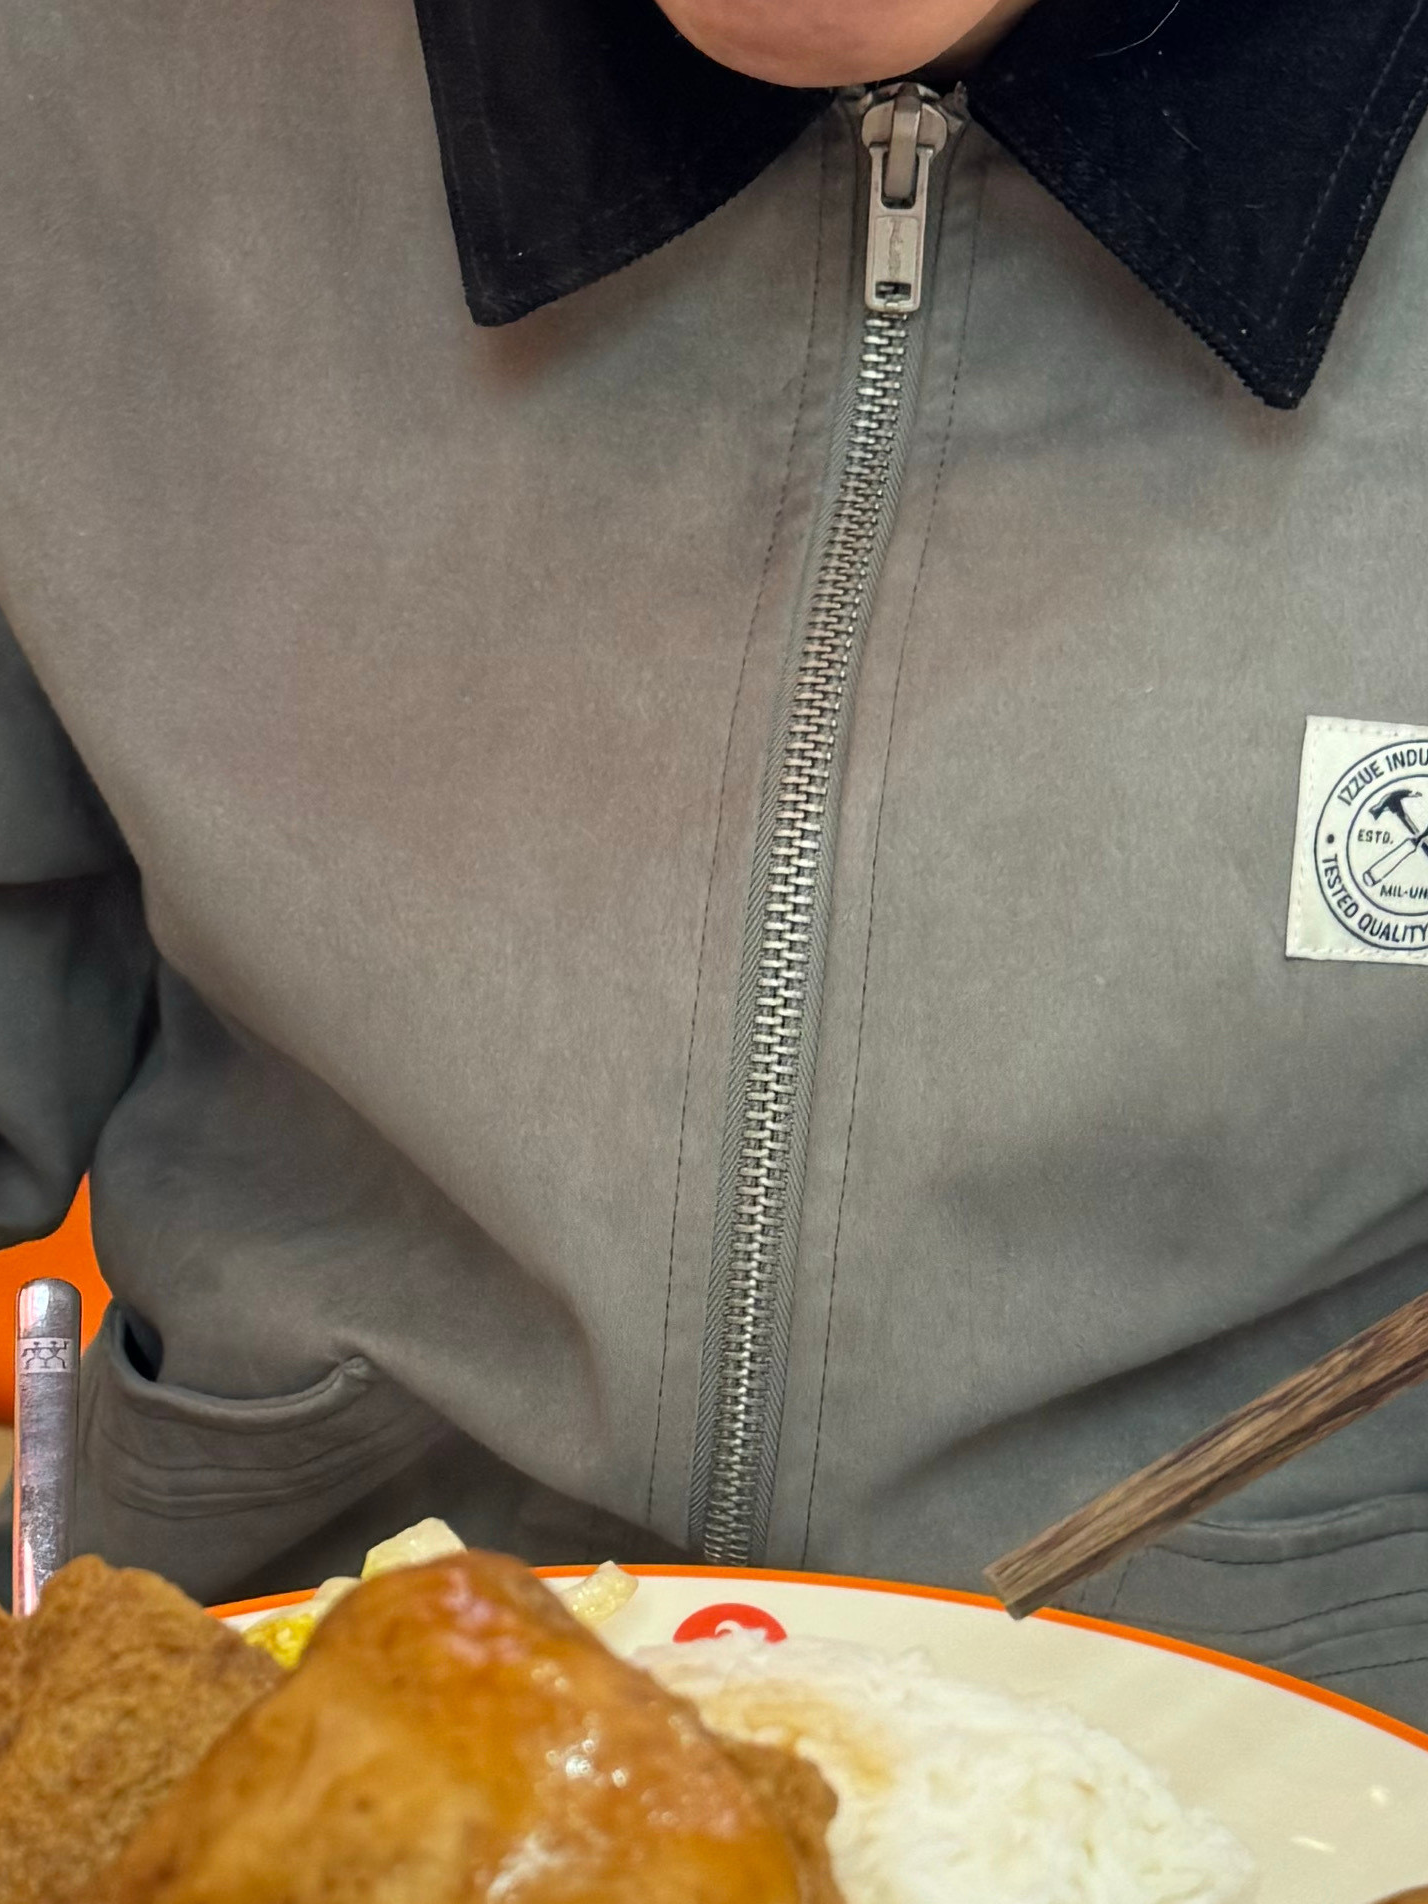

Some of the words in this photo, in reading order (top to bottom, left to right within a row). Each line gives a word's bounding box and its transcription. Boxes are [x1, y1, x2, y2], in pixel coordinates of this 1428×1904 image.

[1337, 760, 1385, 806] IZZUE
[1357, 829, 1394, 845] ESTD.
[1322, 853, 1359, 919] TESTED
